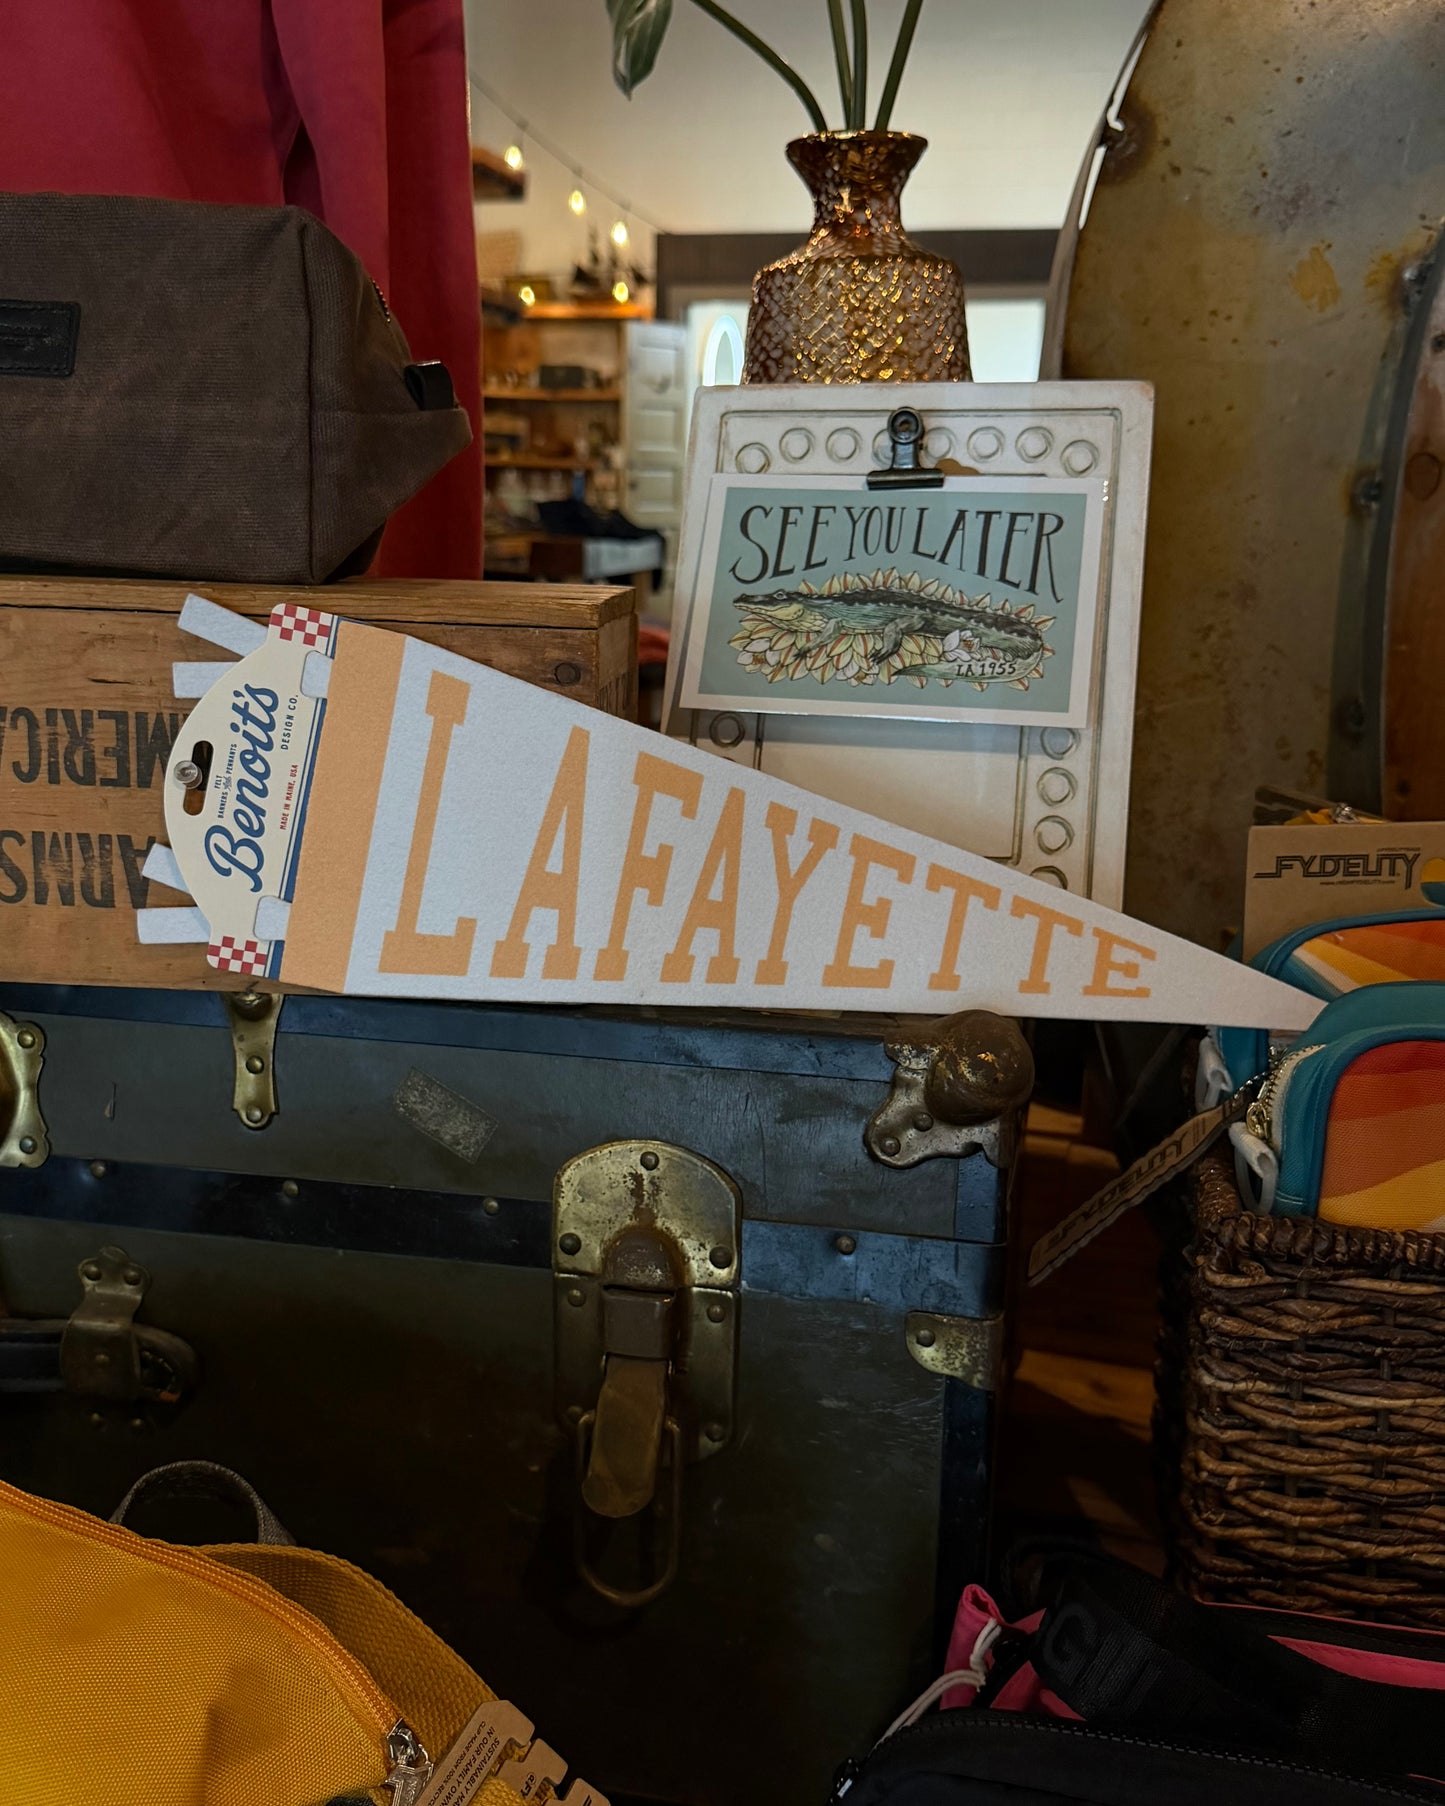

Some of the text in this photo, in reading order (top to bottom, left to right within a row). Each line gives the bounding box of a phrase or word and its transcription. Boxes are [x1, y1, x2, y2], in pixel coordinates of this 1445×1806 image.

[729, 505, 1065, 603] SEE YOU LATER
[956, 661, 1017, 677] LA 1955
[280, 694, 299, 751] DESIGN CO.
[214, 774, 223, 790] FELT
[217, 790, 229, 819] BANNERS
[225, 743, 238, 775] PENNANTS
[289, 764, 299, 778] USA
[204, 683, 279, 893] Benoit's
[283, 802, 291, 812] IN
[280, 811, 290, 831] MADE
[378, 669, 1157, 1000] LAFAYETTE
[0, 829, 157, 910] ARMS
[1253, 852, 1421, 890] FYDELITY
[464, 1733, 478, 1753] MADE
[486, 1725, 496, 1739] IN
[454, 1750, 467, 1770] FROM
[474, 1736, 489, 1757] OUR
[455, 1754, 477, 1788] FAMILY
[464, 1737, 500, 1795] SUSTAINABLY
